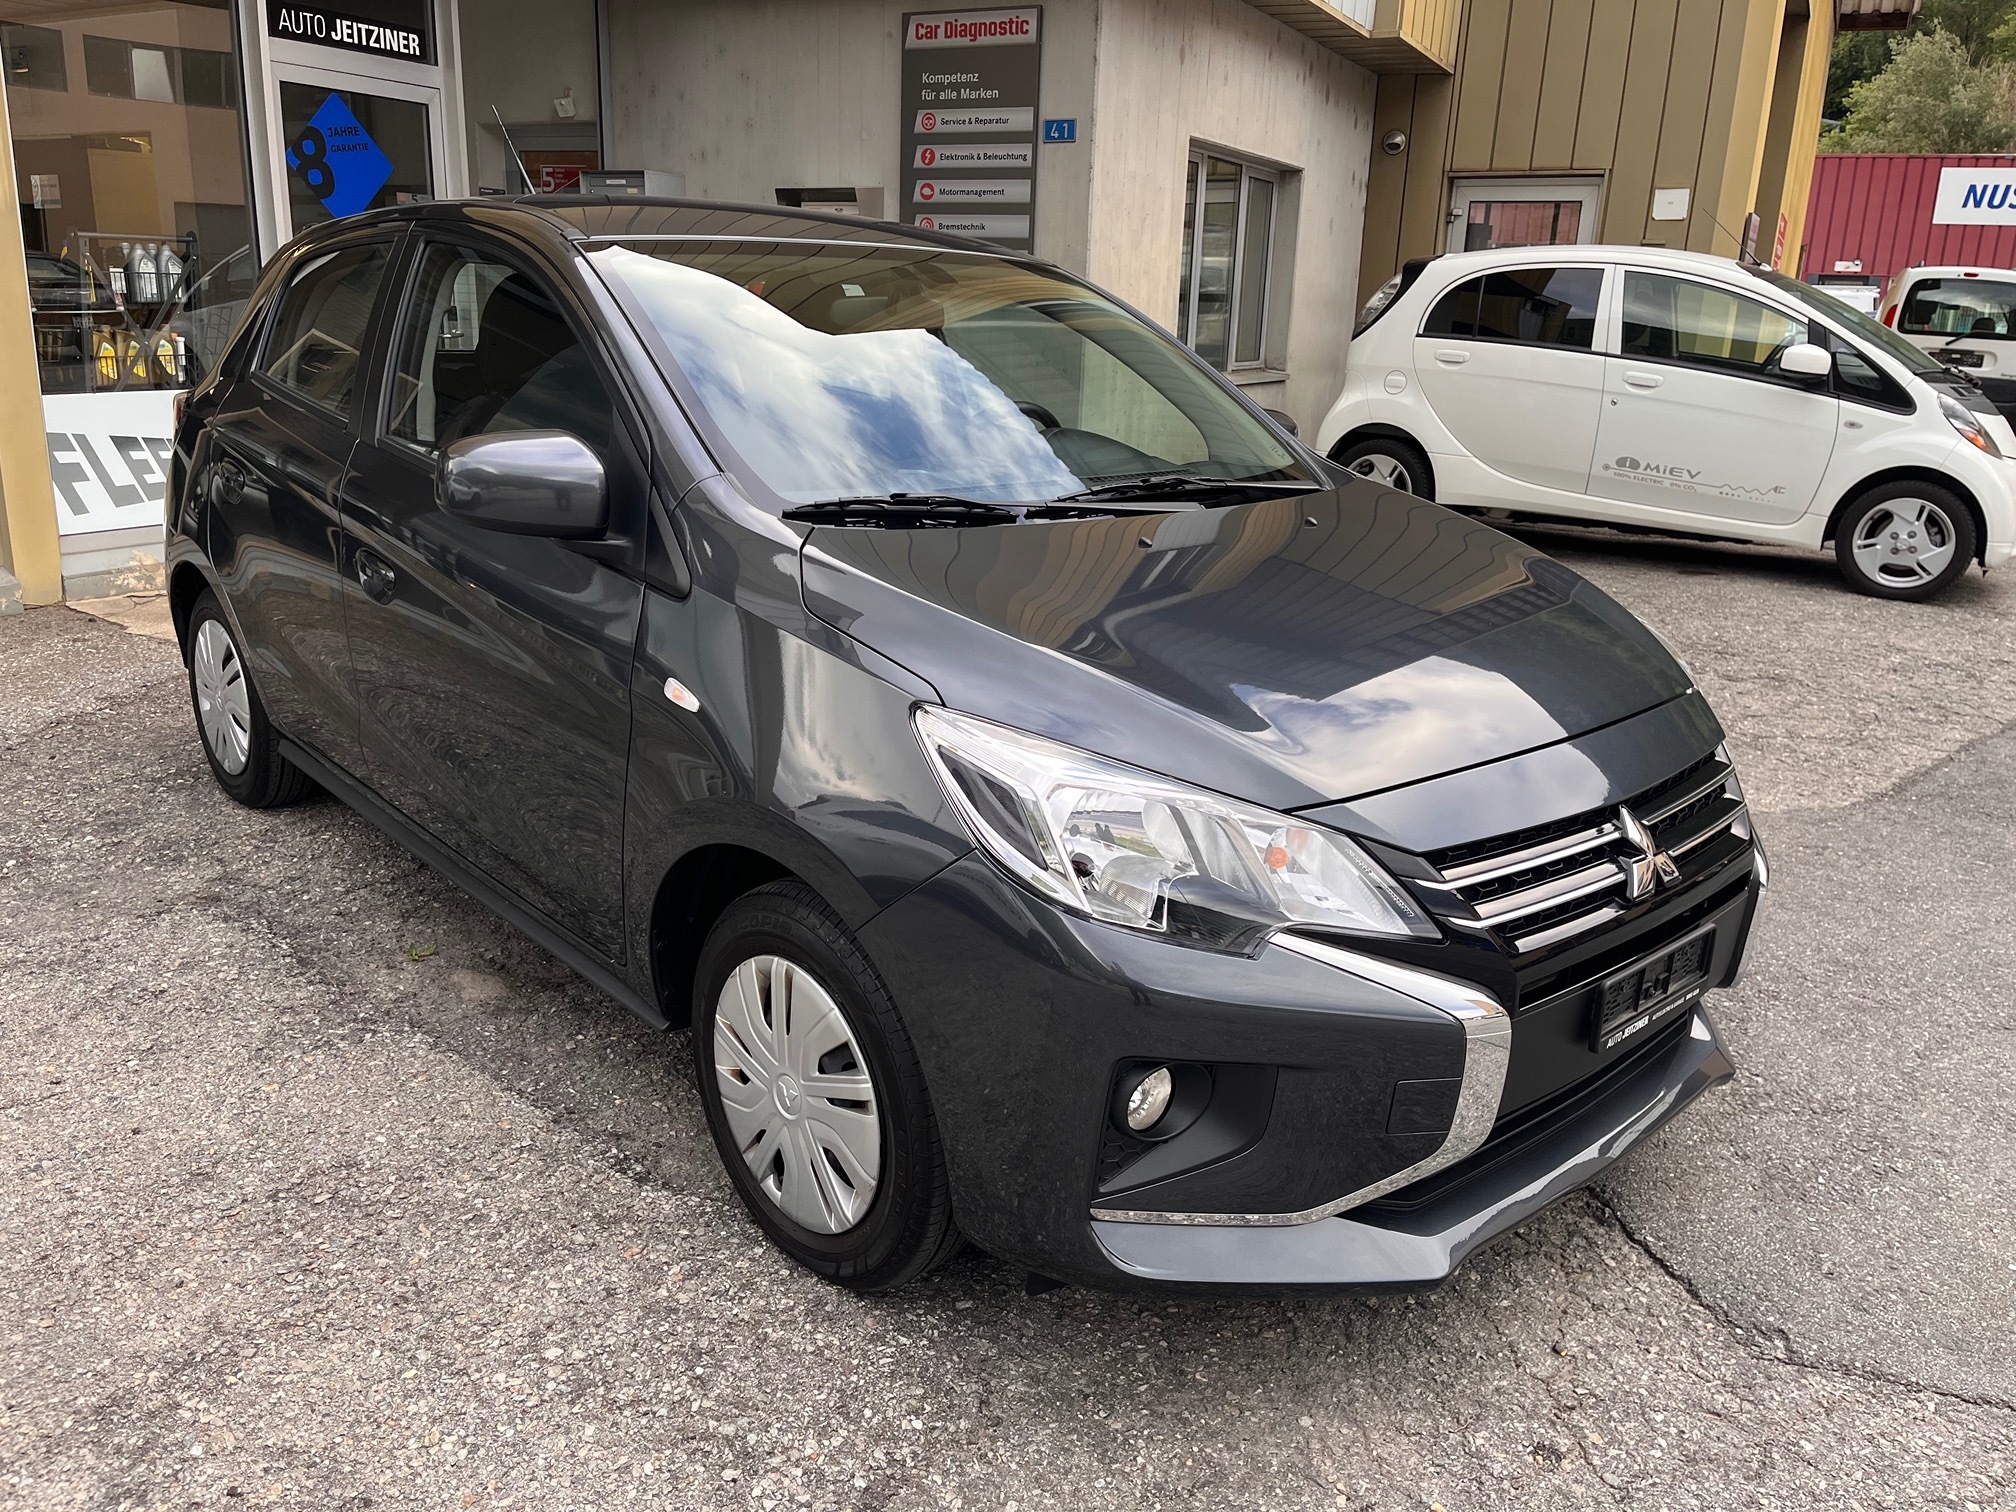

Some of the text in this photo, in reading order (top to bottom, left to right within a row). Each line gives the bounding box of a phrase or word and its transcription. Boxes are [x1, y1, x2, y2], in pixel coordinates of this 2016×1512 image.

[279, 8, 420, 56] AUTO JEITZINER
[915, 16, 1030, 42] Car Diagnostic
[922, 72, 979, 85] Kompetenz
[921, 88, 999, 100] für alle Marken
[940, 117, 1010, 126] Service & Reparatur
[327, 126, 360, 138] JAHRE
[1050, 122, 1068, 139] 41
[330, 142, 369, 153] GARANTIE
[291, 125, 336, 200] 8
[940, 152, 1028, 162] Elektronik & Beleuchtung
[542, 167, 555, 193] 5
[939, 188, 1005, 197] Motormanagement
[938, 223, 986, 232] Bremstechnik
[1643, 462, 1701, 480] MiEV
[1613, 471, 1632, 480] 100%
[1633, 475, 1665, 486] ELECTRIC
